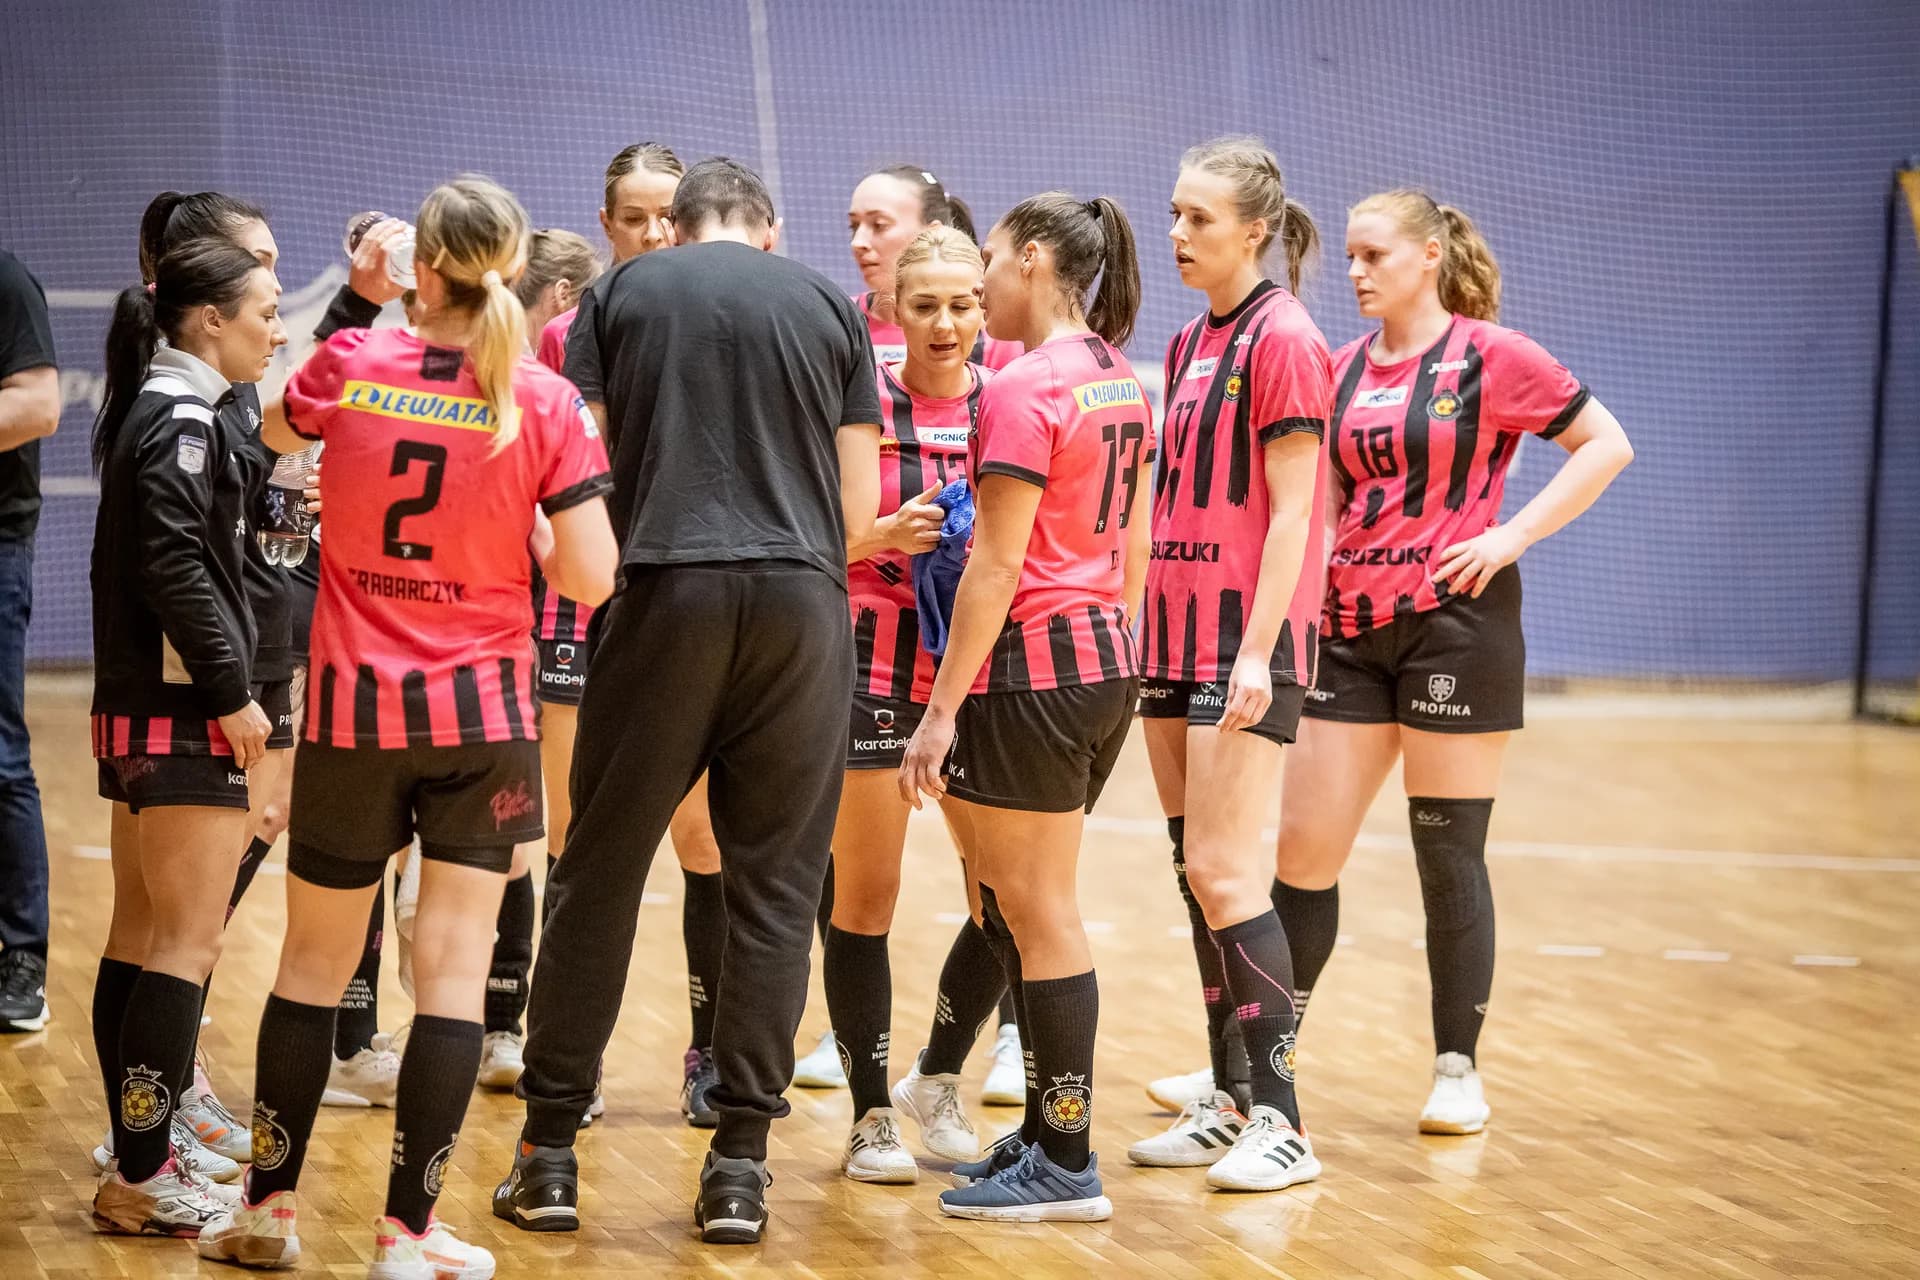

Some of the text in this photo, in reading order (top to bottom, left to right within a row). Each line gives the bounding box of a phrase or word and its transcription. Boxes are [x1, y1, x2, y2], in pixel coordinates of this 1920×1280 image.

[1098, 382, 1141, 403] LEWIATA
[1351, 426, 1398, 478] 18
[1094, 422, 1144, 534] 13
[383, 439, 447, 561] 2
[1150, 541, 1220, 563] SUZUKI
[1337, 546, 1433, 566] SUZUKI
[1189, 694, 1227, 707] ROFIK
[1411, 699, 1471, 717] PROFIKA
[1056, 1088, 1084, 1098] SUZUKI
